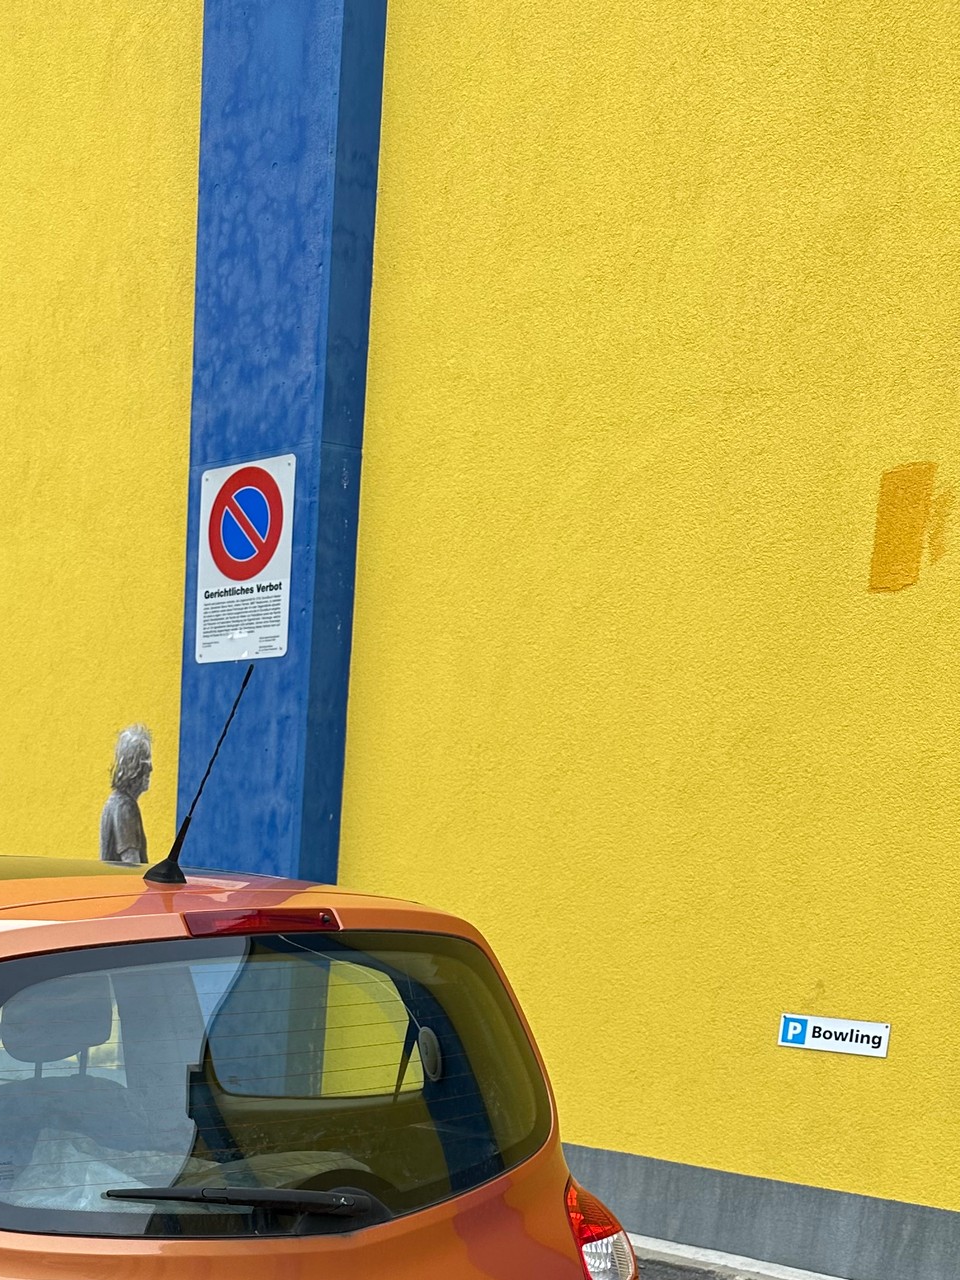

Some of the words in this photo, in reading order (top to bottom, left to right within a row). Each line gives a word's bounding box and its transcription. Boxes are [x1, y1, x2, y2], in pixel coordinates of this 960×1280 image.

[204, 586, 254, 599] Gerichtliches
[256, 581, 282, 593] Verbot
[787, 1021, 802, 1040] P
[811, 1025, 882, 1049] Bowling
